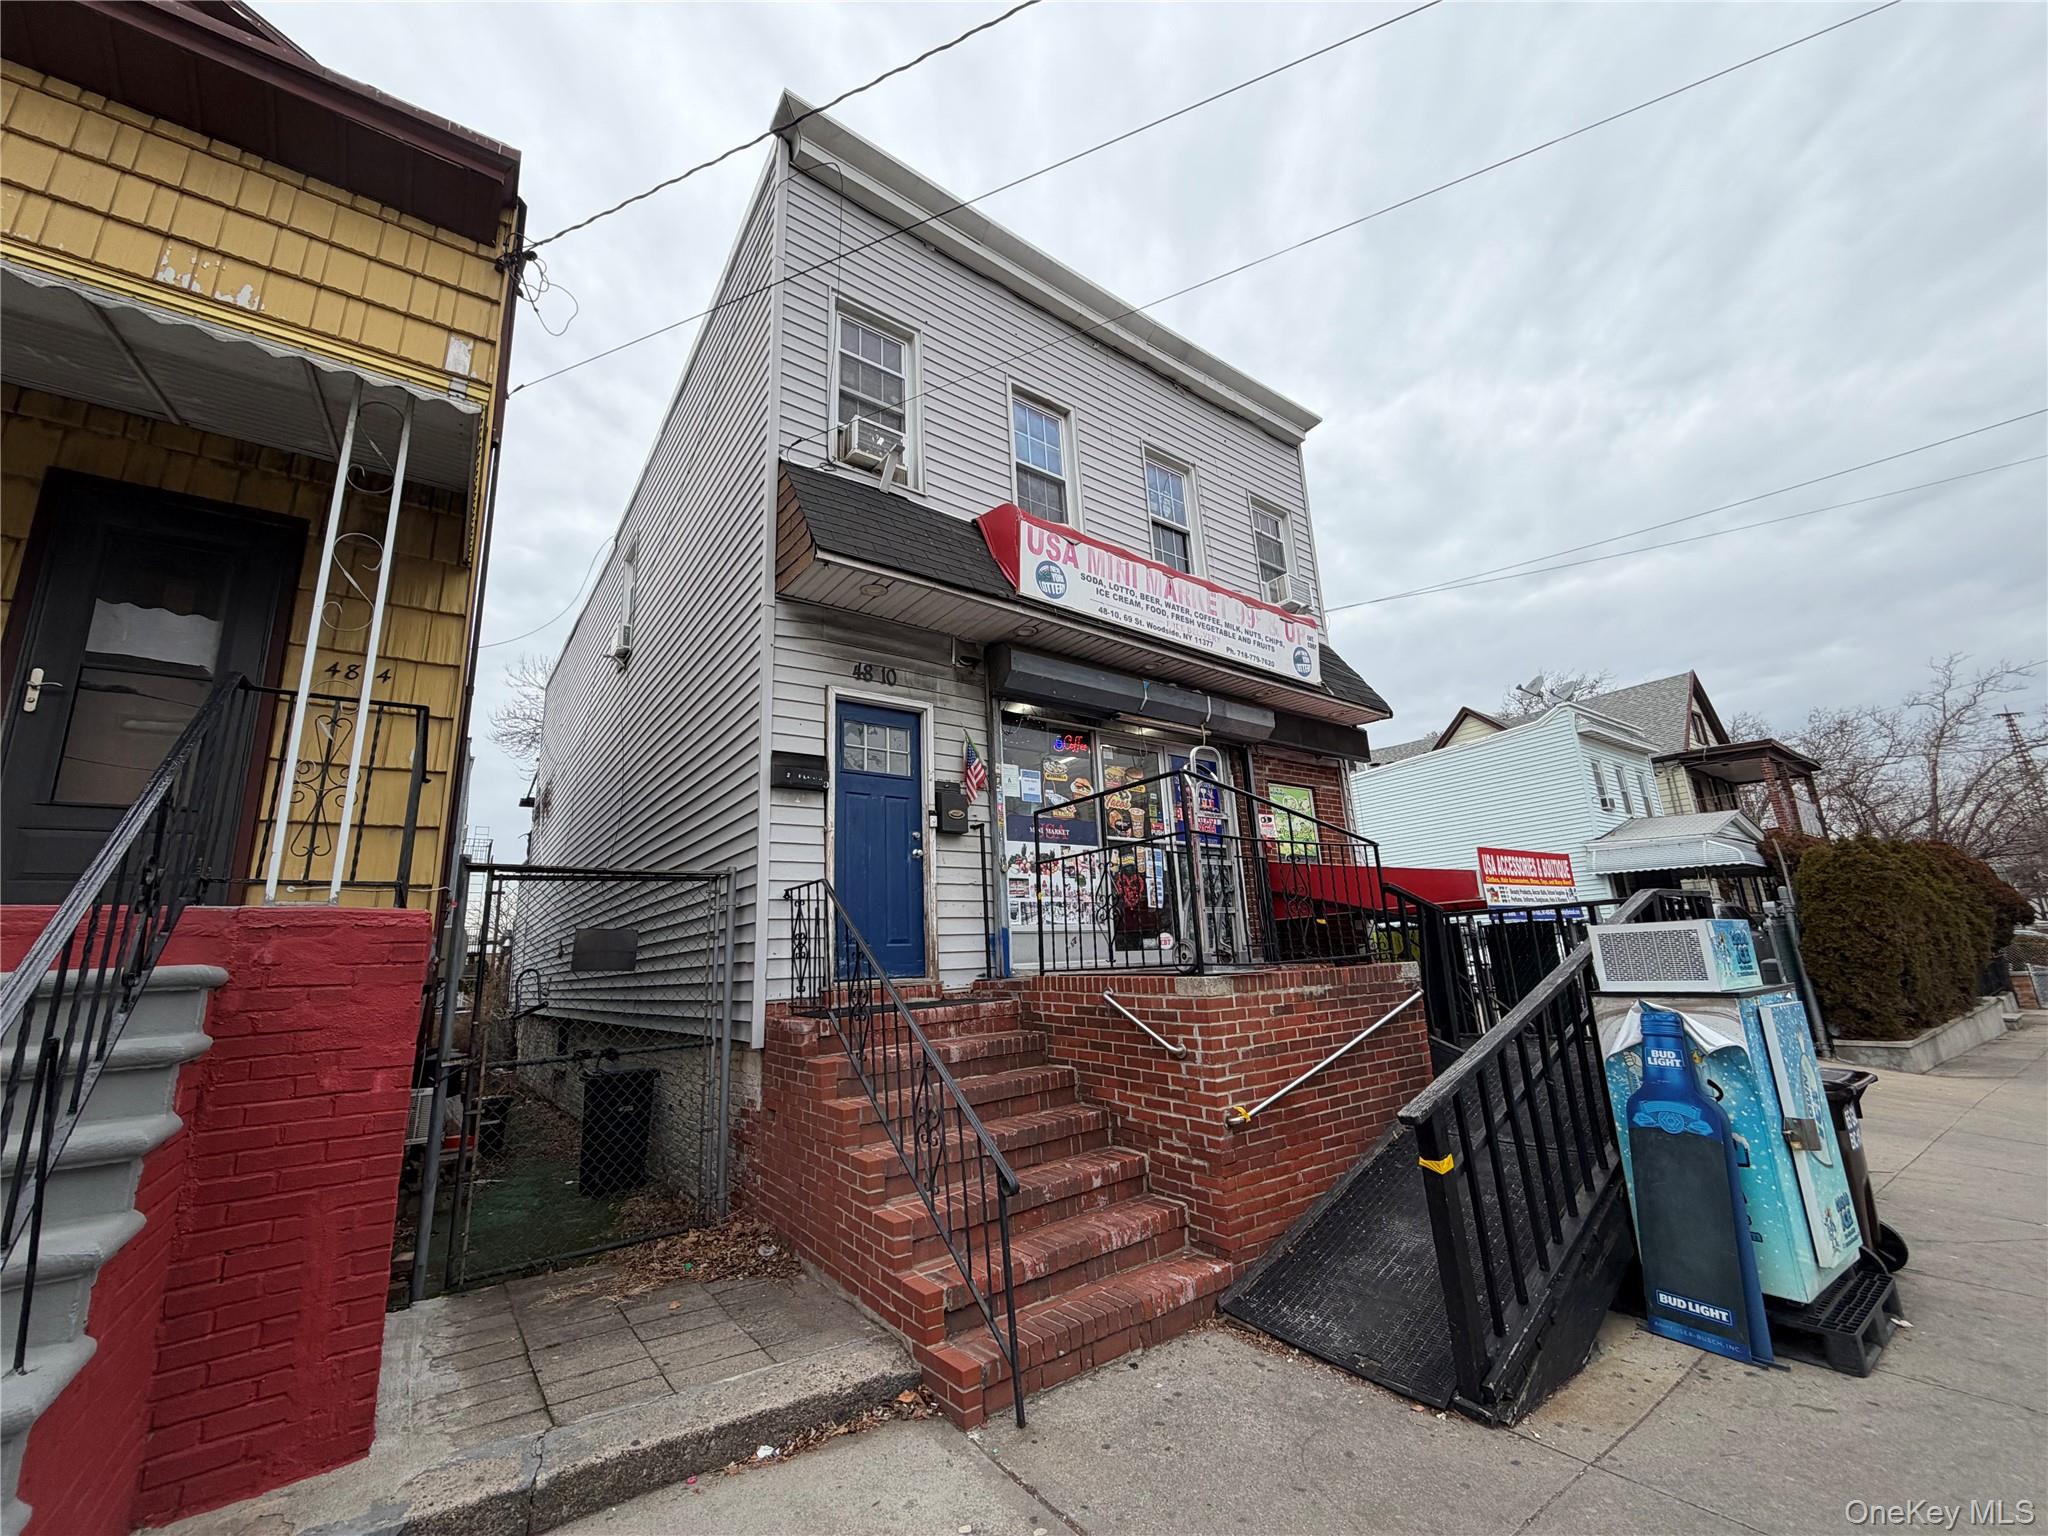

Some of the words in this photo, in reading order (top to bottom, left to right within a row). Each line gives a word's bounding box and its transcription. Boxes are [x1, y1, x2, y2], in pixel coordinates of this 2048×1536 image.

[1027, 525, 1079, 570] USA
[1080, 572, 1106, 589] SODA,
[1109, 582, 1137, 599] LOTTO,
[1140, 592, 1162, 607] BEER,
[1165, 601, 1192, 617] WATER,
[1194, 611, 1223, 627] COFFEE,
[1224, 621, 1243, 634] MILK,
[1244, 628, 1263, 641] NUTS,
[1265, 635, 1285, 648] CHIPS,
[1095, 587, 1110, 598] ICE
[1112, 593, 1143, 610] CREAM,
[1145, 604, 1169, 618] FOOD,
[1171, 612, 1195, 626] FRESH
[1196, 620, 1236, 640] VEGETABLE
[1237, 636, 1252, 646] AND
[1253, 639, 1276, 652] FRUITS
[1146, 621, 1182, 639] Woodside,
[1183, 633, 1193, 641] NY
[1194, 636, 1214, 648] 11377
[852, 661, 874, 682] 48
[881, 666, 897, 687] 10
[1064, 734, 1089, 753] Coffee
[1045, 828, 1070, 836] MARKET
[1647, 1056, 1682, 1068] LIGHT
[1650, 1049, 1677, 1059] BUD
[1659, 1292, 1687, 1309] BUD
[1687, 1300, 1729, 1322] LIGHT
